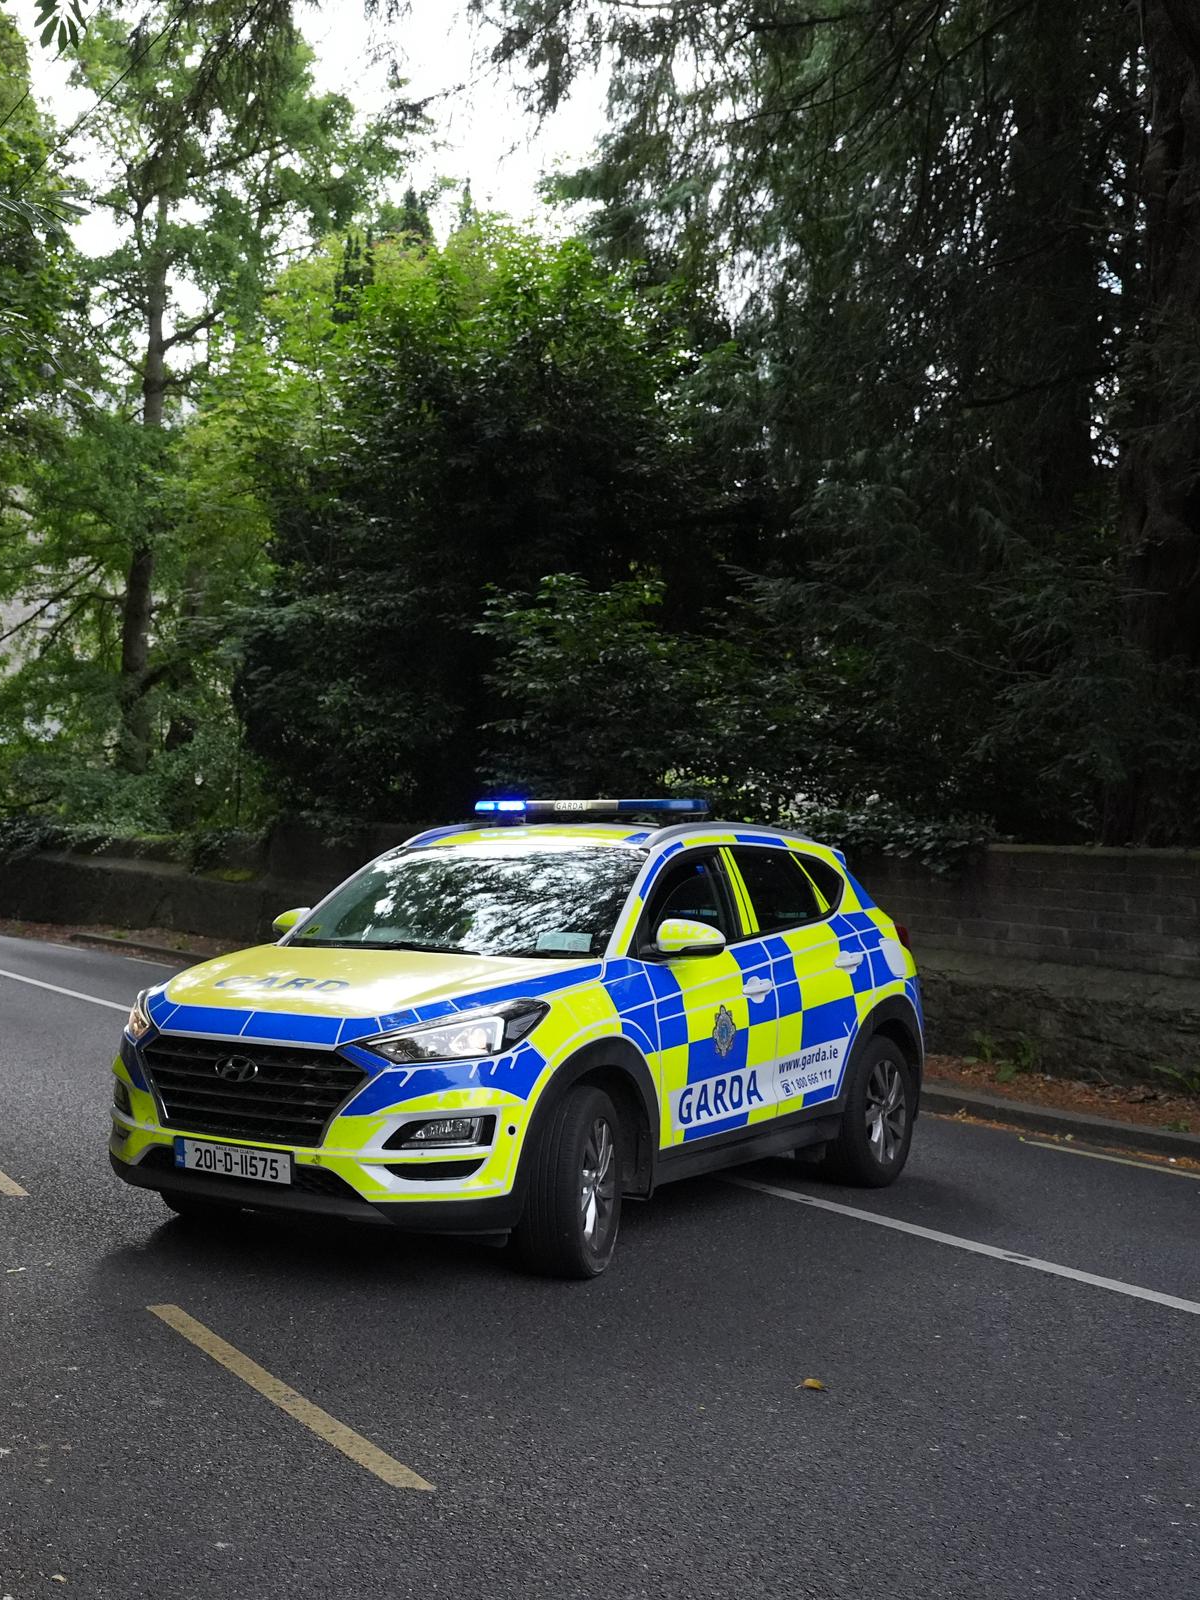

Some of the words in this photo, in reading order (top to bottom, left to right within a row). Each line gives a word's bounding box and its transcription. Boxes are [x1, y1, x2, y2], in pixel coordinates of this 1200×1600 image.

[556, 802, 584, 810] GARDA
[214, 976, 351, 992] GARD
[778, 1045, 839, 1071] www.garda.ie
[820, 1068, 832, 1081] 111
[678, 1070, 763, 1125] GARDA
[194, 1147, 279, 1180] 201-D-11575
